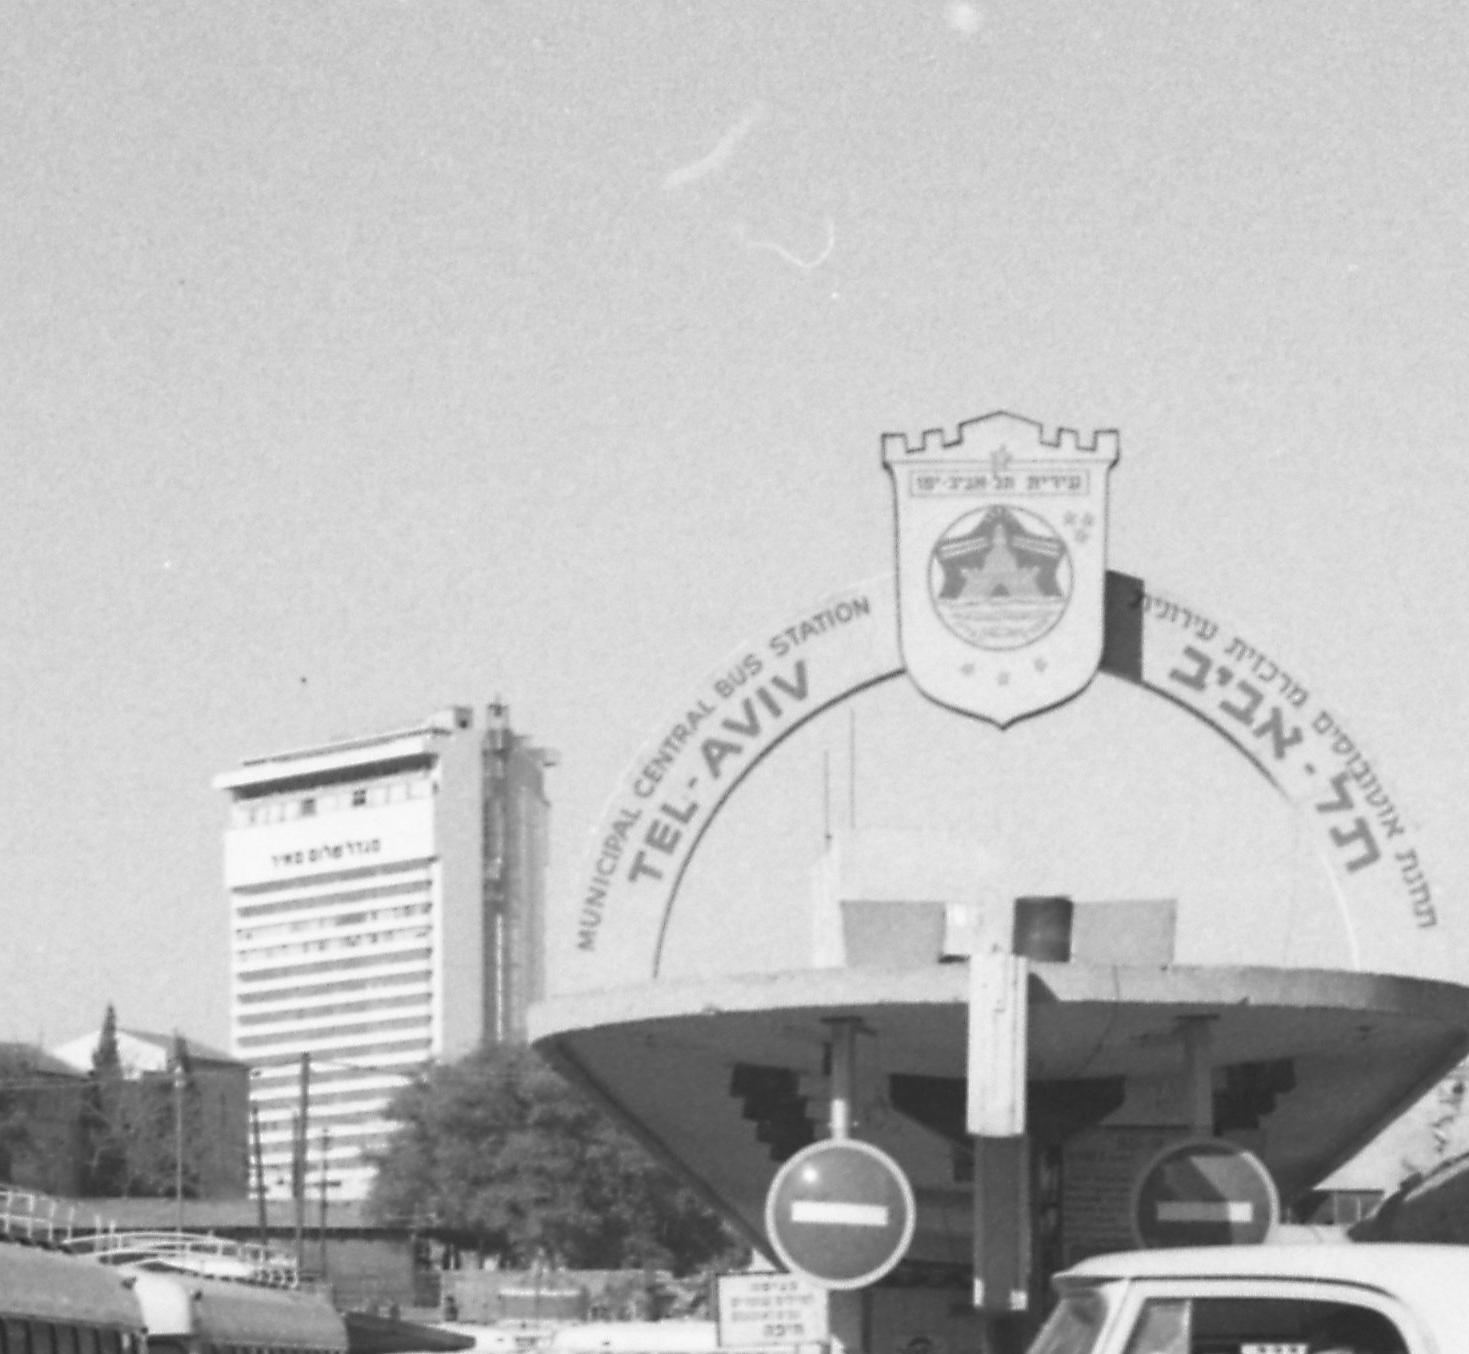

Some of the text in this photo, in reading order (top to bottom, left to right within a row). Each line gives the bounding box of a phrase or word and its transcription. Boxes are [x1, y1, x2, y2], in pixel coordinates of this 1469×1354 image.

[1224, 636, 1309, 707] מרכזית
[577, 596, 872, 951] MUNICIPAL CENTRAL BUS STATION
[1312, 710, 1405, 838] אוטובוסים
[1396, 848, 1437, 929] תחנת
